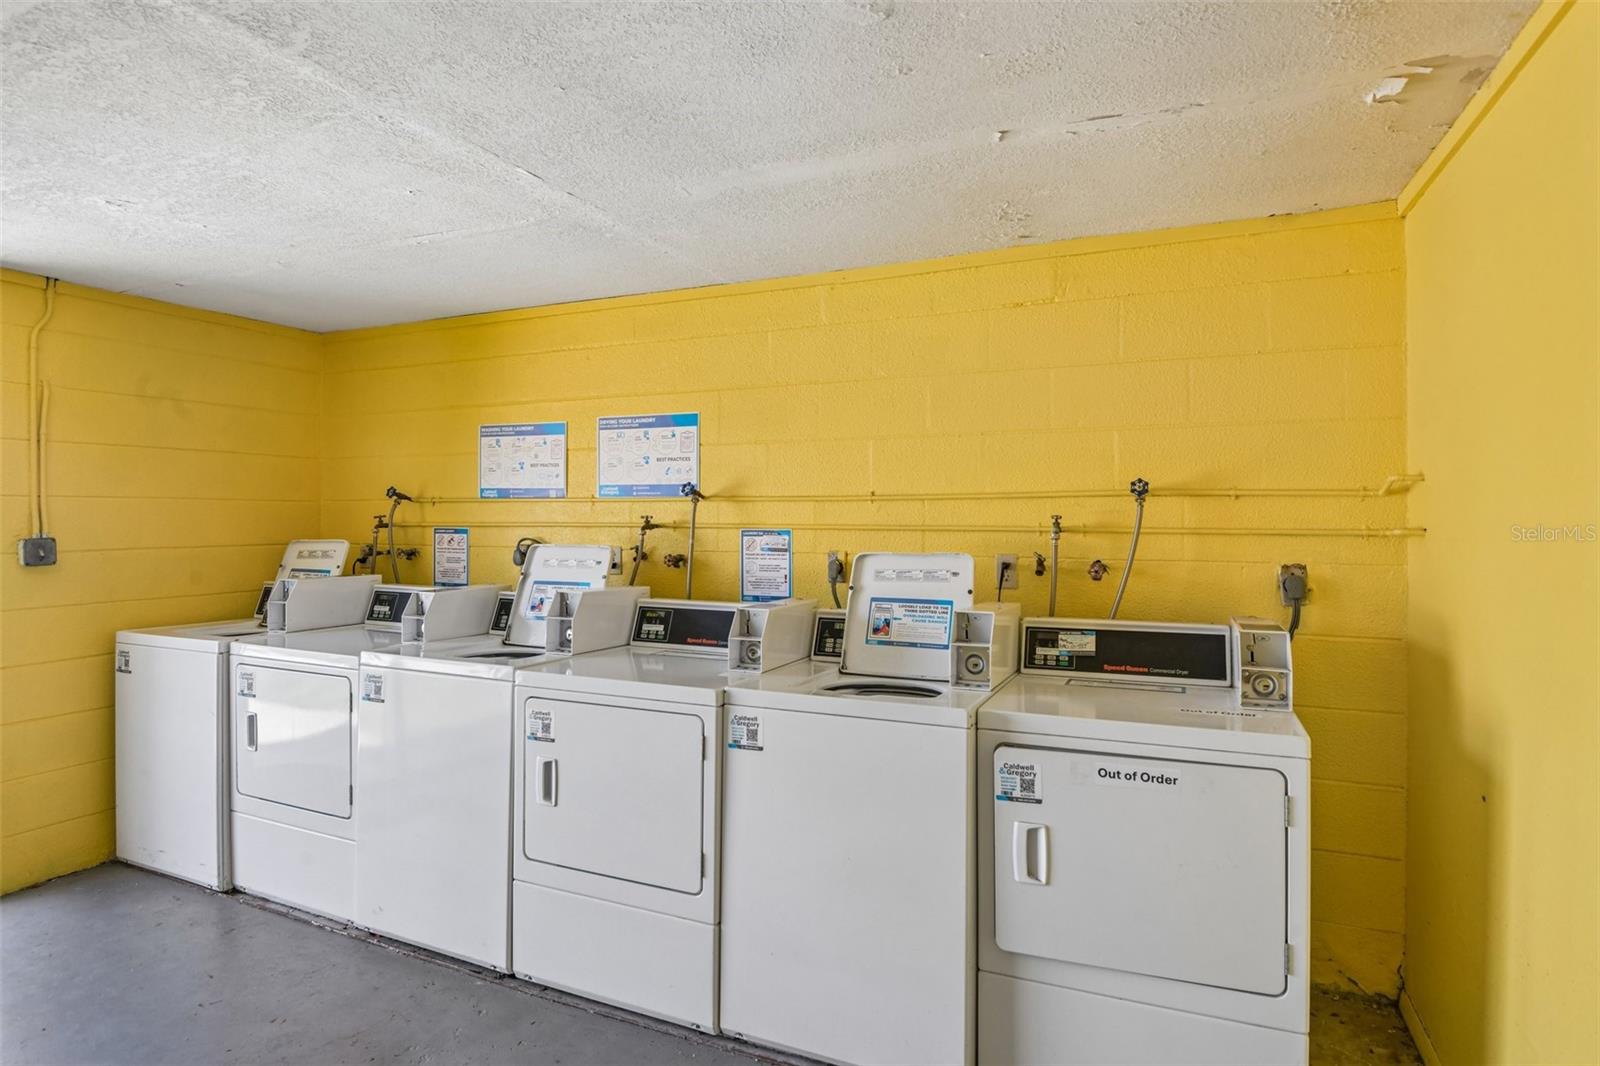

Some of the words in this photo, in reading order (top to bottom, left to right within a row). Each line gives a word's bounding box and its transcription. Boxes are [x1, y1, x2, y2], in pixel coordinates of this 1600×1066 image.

[1103, 664, 1125, 672] Speed
[1176, 668, 1189, 676] Dryer
[734, 714, 758, 722] Caldwell
[736, 720, 759, 728] Gregory
[1003, 762, 1035, 771] Caldwell
[1006, 769, 1037, 778] Gregory
[1097, 767, 1122, 780] Out
[1124, 769, 1139, 781] of
[1140, 771, 1179, 786] Order
